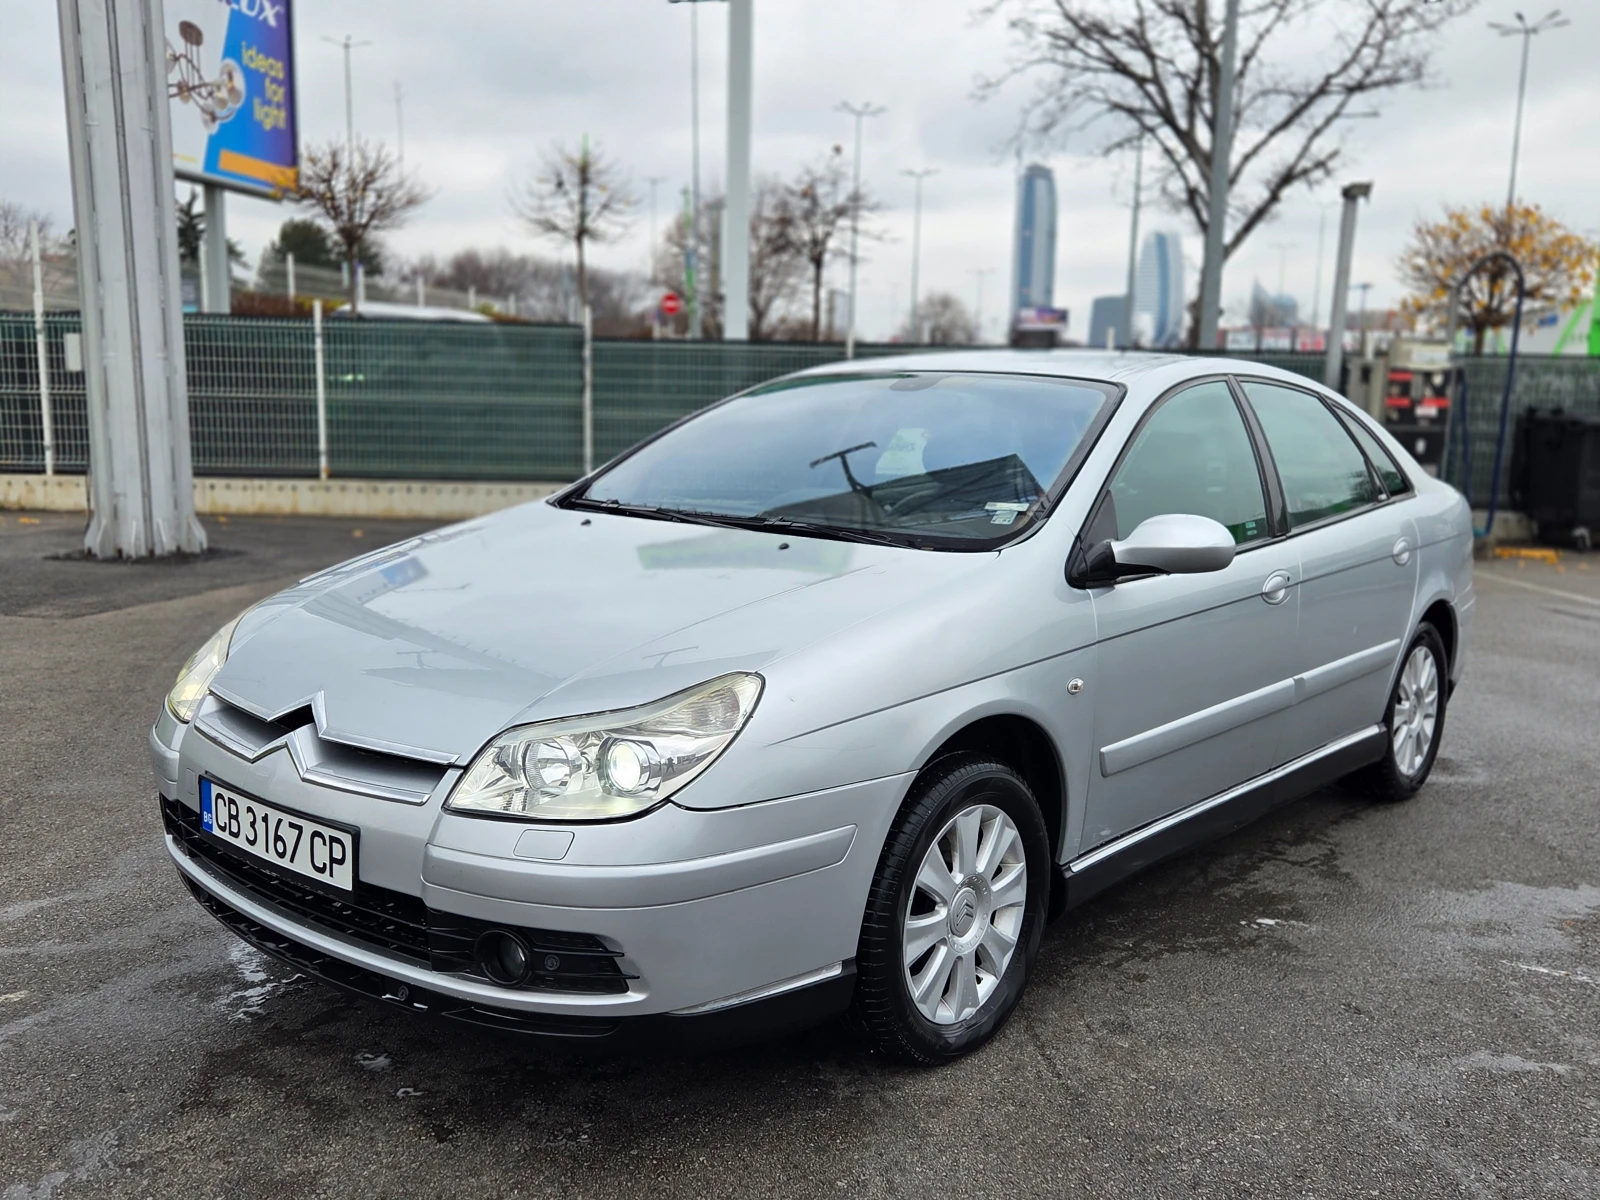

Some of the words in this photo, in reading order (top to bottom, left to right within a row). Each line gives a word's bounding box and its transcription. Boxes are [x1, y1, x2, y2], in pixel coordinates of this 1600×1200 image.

[241, 40, 284, 79] ideas
[265, 78, 284, 102] for
[253, 96, 285, 130] light
[203, 810, 213, 825] BG
[214, 792, 241, 839] CB
[245, 805, 304, 864] 3167
[310, 829, 347, 878] CP
